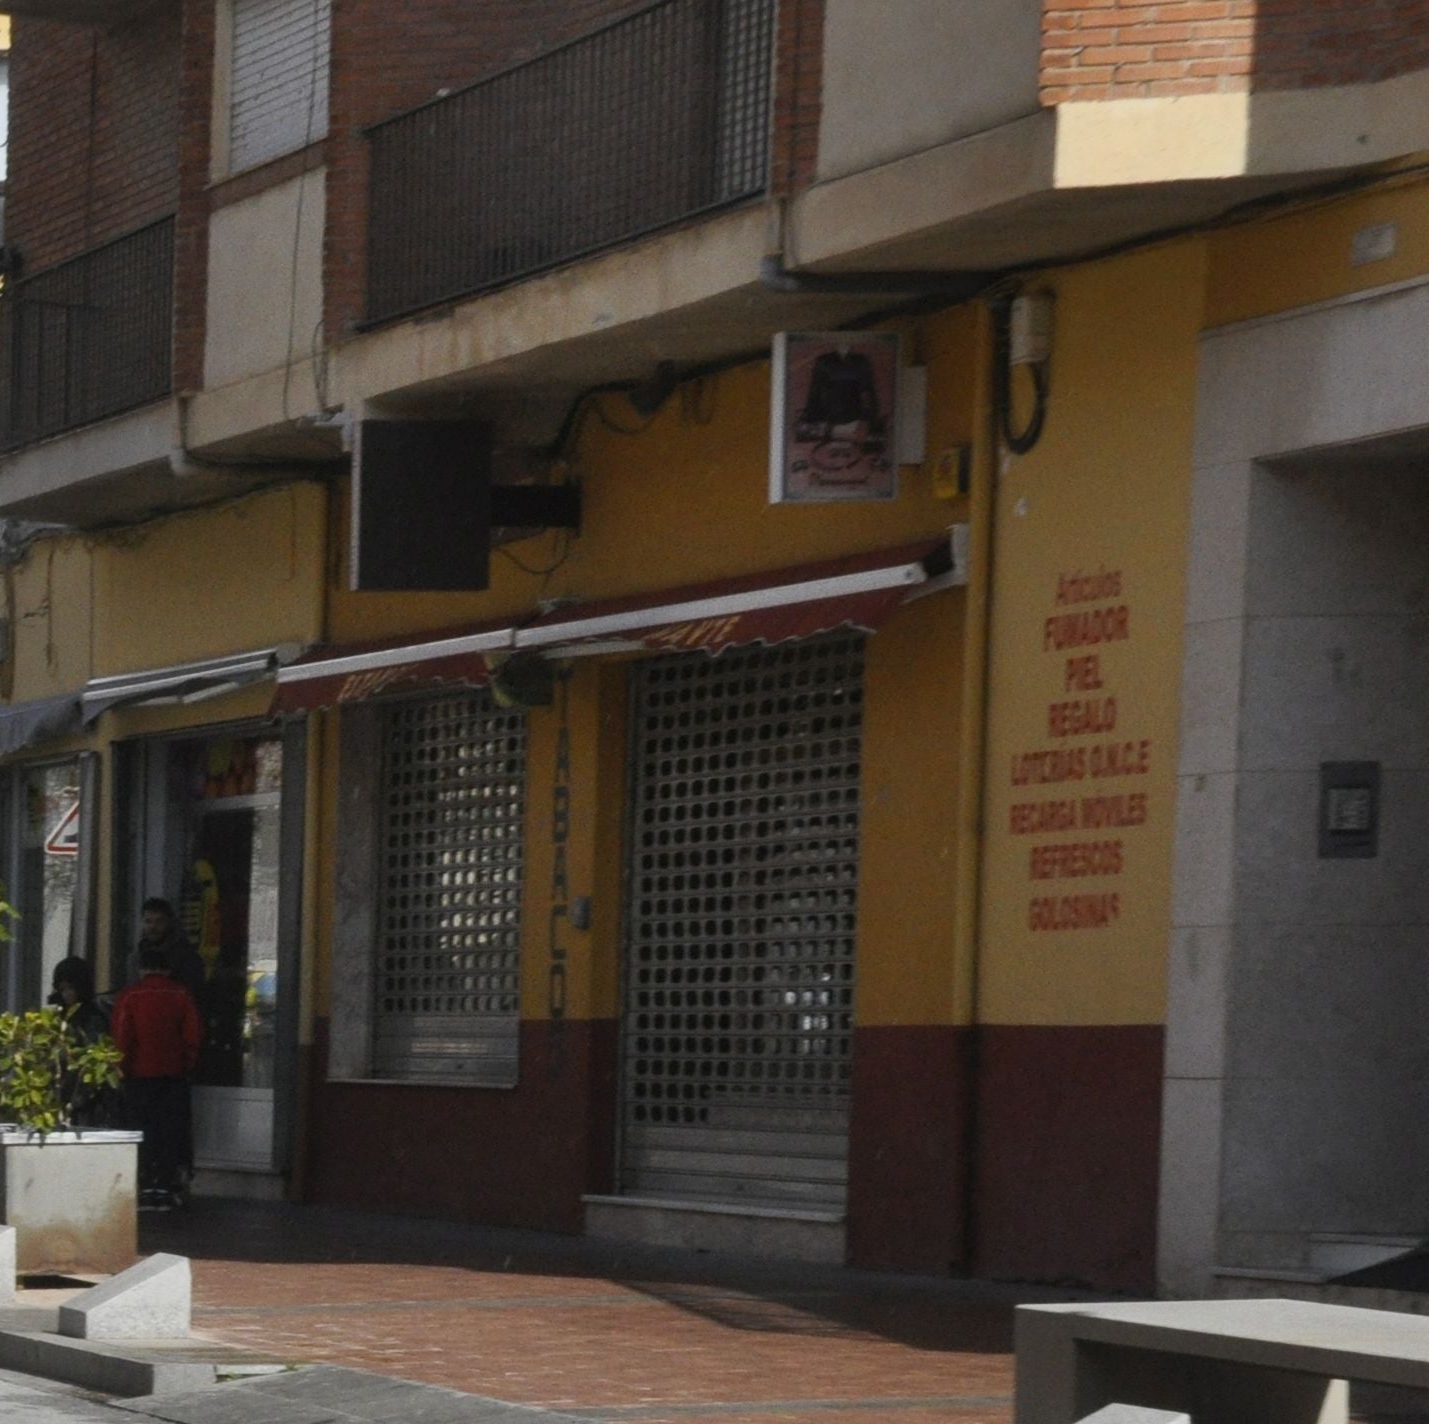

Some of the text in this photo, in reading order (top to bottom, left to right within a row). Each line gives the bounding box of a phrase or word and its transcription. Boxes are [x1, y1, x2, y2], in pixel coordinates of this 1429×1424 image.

[1045, 605, 1129, 649] FUMADOR
[1065, 655, 1103, 691] PIEL
[1047, 698, 1116, 737] REGALO
[1011, 800, 1076, 834] RECARGA
[1029, 840, 1123, 880] REFRESCOS
